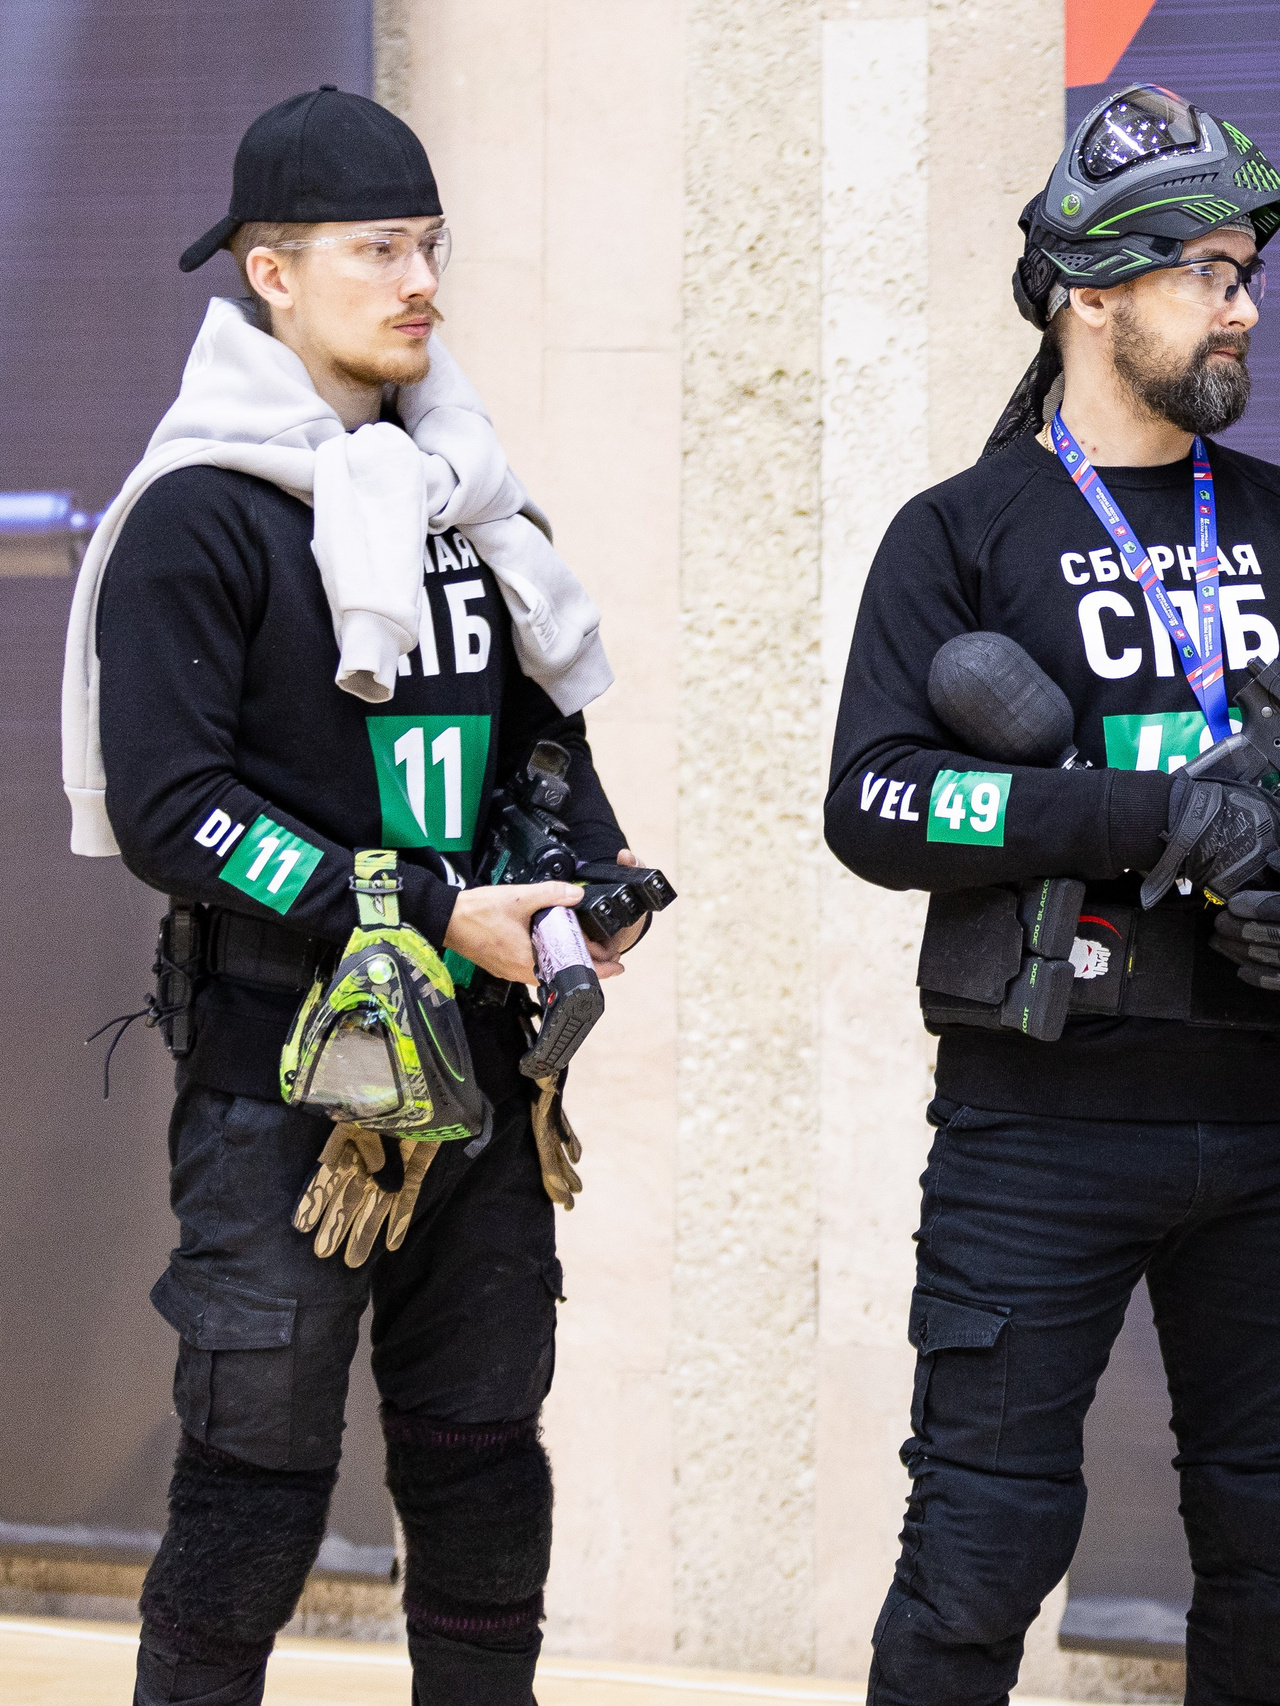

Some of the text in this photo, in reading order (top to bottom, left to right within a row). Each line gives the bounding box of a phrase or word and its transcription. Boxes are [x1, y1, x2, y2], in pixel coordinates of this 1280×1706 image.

[394, 726, 462, 839] 11
[860, 771, 1001, 833] VEL 49
[193, 808, 301, 894] DI 11
